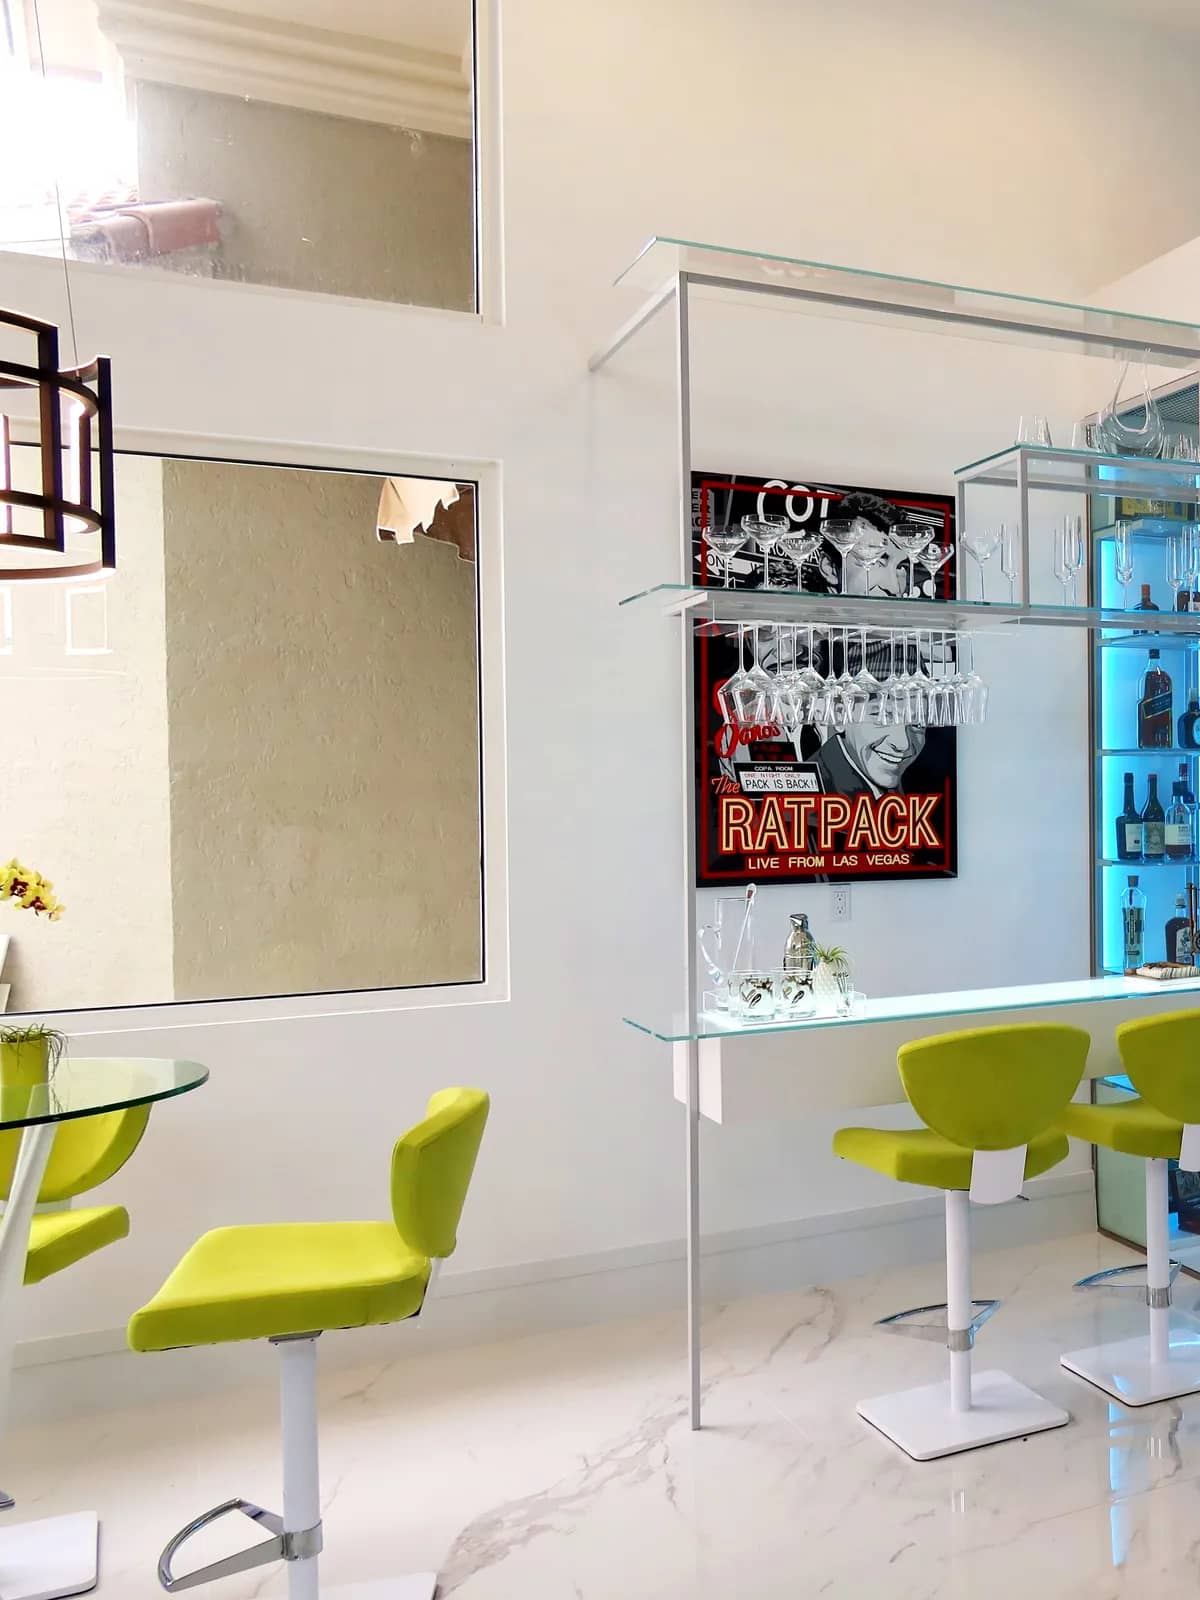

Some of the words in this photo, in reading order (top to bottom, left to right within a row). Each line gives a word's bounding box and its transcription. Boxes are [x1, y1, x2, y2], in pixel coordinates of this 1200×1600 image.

[711, 775, 740, 795] The
[745, 779, 770, 789] PACK
[774, 779, 784, 789] IS
[748, 857, 780, 870] LIVE
[788, 855, 825, 868] FROM
[832, 854, 858, 867] LAS
[866, 853, 910, 866] VEGAS
